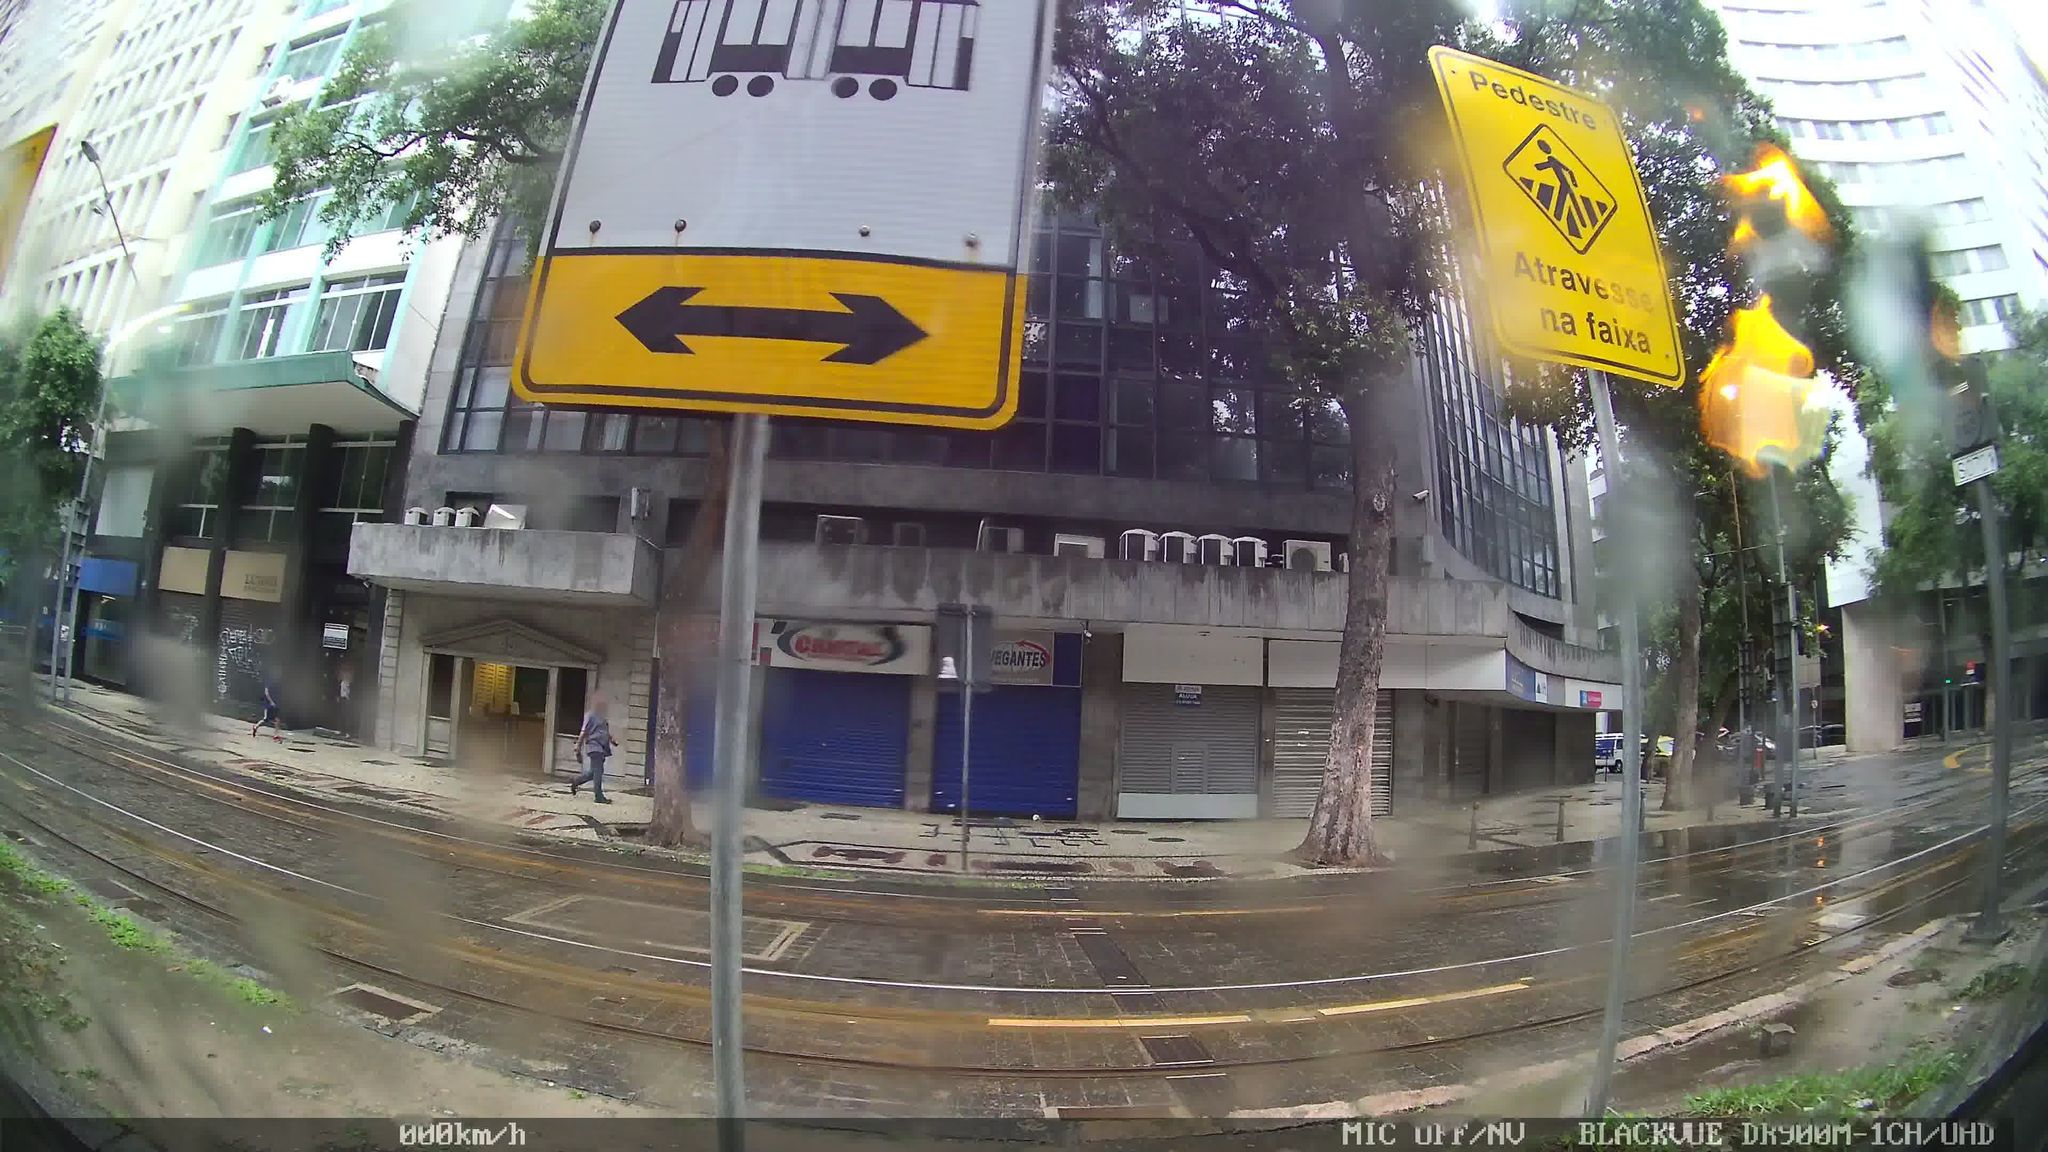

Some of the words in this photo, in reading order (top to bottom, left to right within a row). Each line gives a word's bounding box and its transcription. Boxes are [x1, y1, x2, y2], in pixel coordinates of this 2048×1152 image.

[1468, 70, 1598, 130] Pedestre
[1513, 250, 1655, 313] Atravesse
[1540, 307, 1578, 337] na
[1586, 311, 1653, 355] faixa
